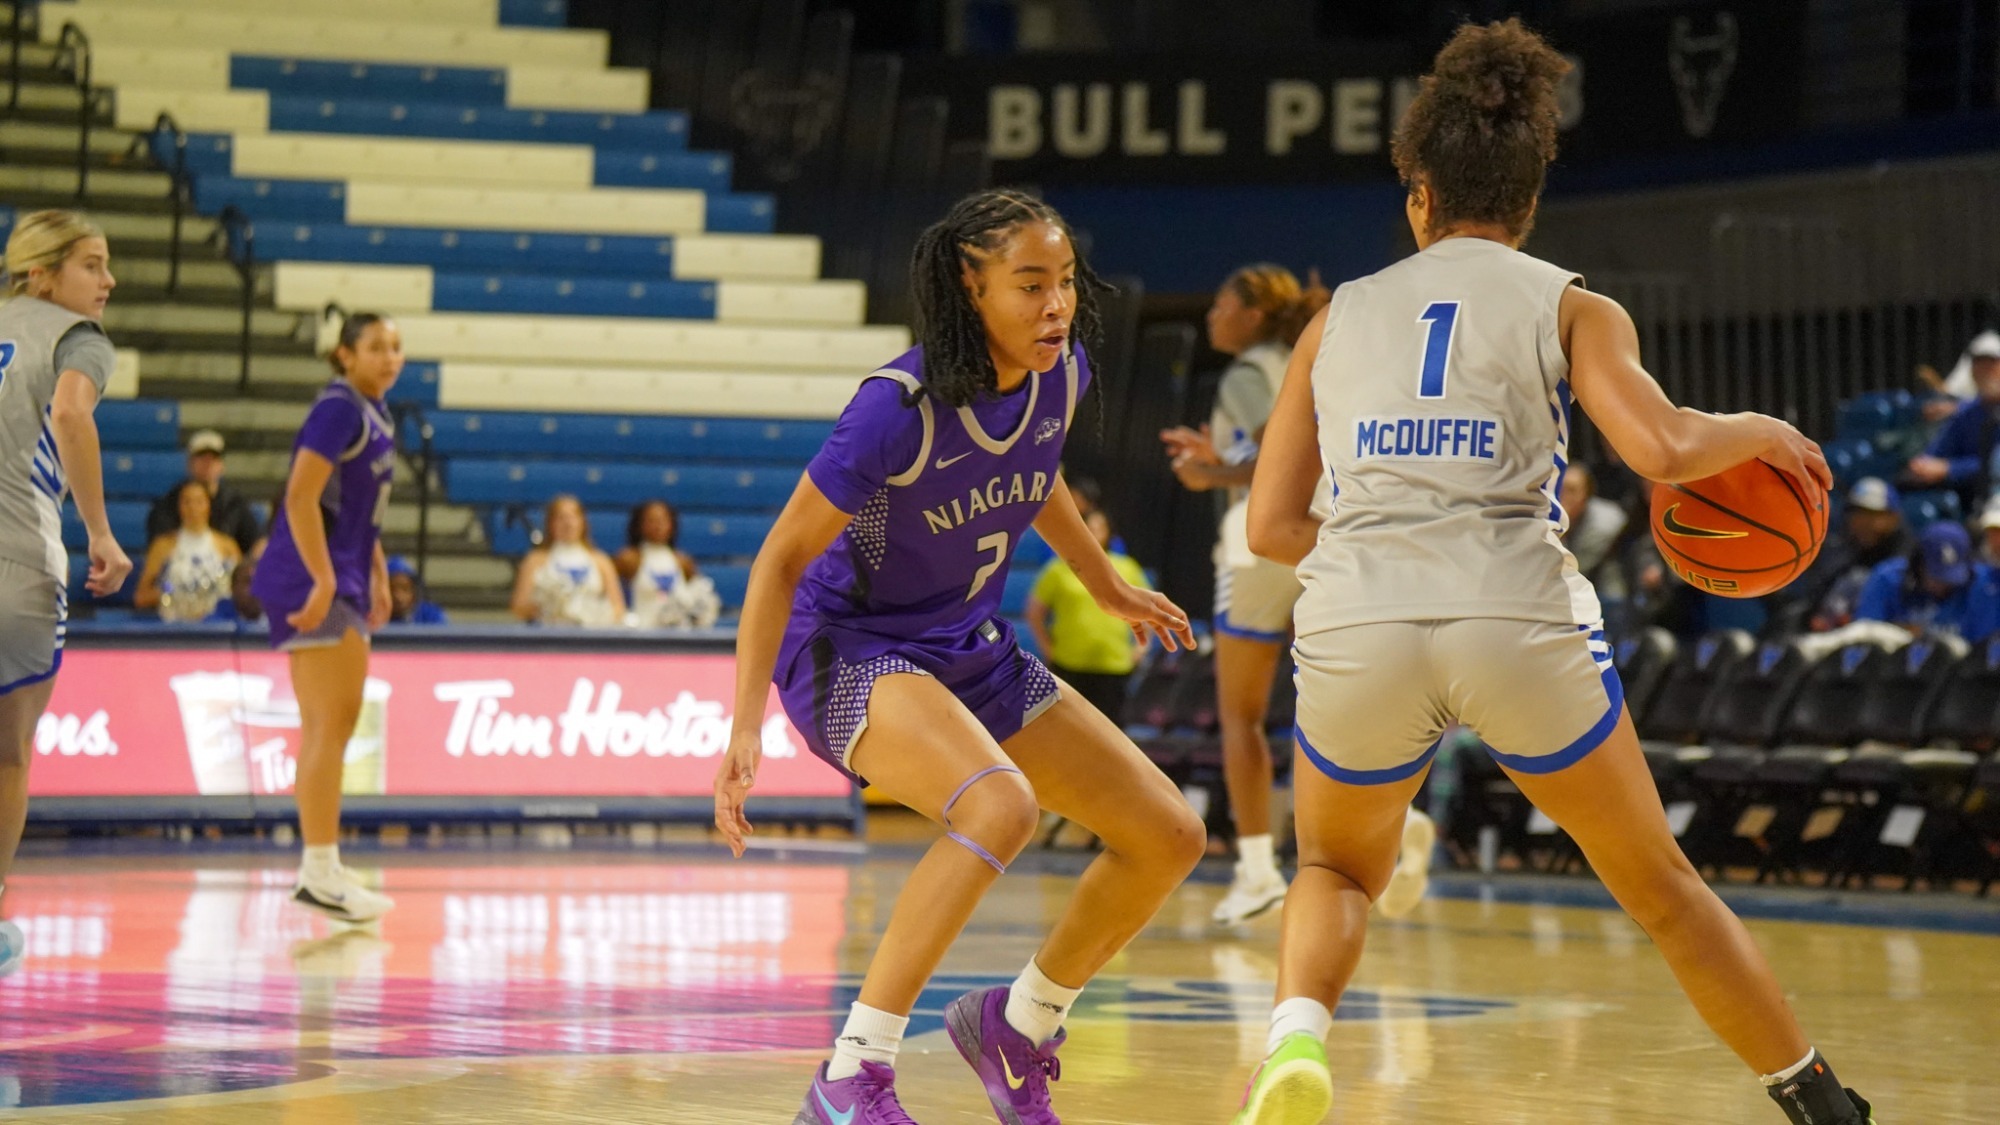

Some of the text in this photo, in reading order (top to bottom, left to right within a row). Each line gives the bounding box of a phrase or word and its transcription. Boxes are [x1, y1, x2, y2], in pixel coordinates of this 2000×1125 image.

[990, 80, 1416, 157] BULL PE
[1416, 300, 1462, 399] 1
[1357, 419, 1496, 458] McDUFFIE
[922, 471, 1054, 535] NIAGAR
[1660, 550, 1739, 593] ELI
[434, 679, 553, 758] Tim
[250, 737, 297, 793] Ti
